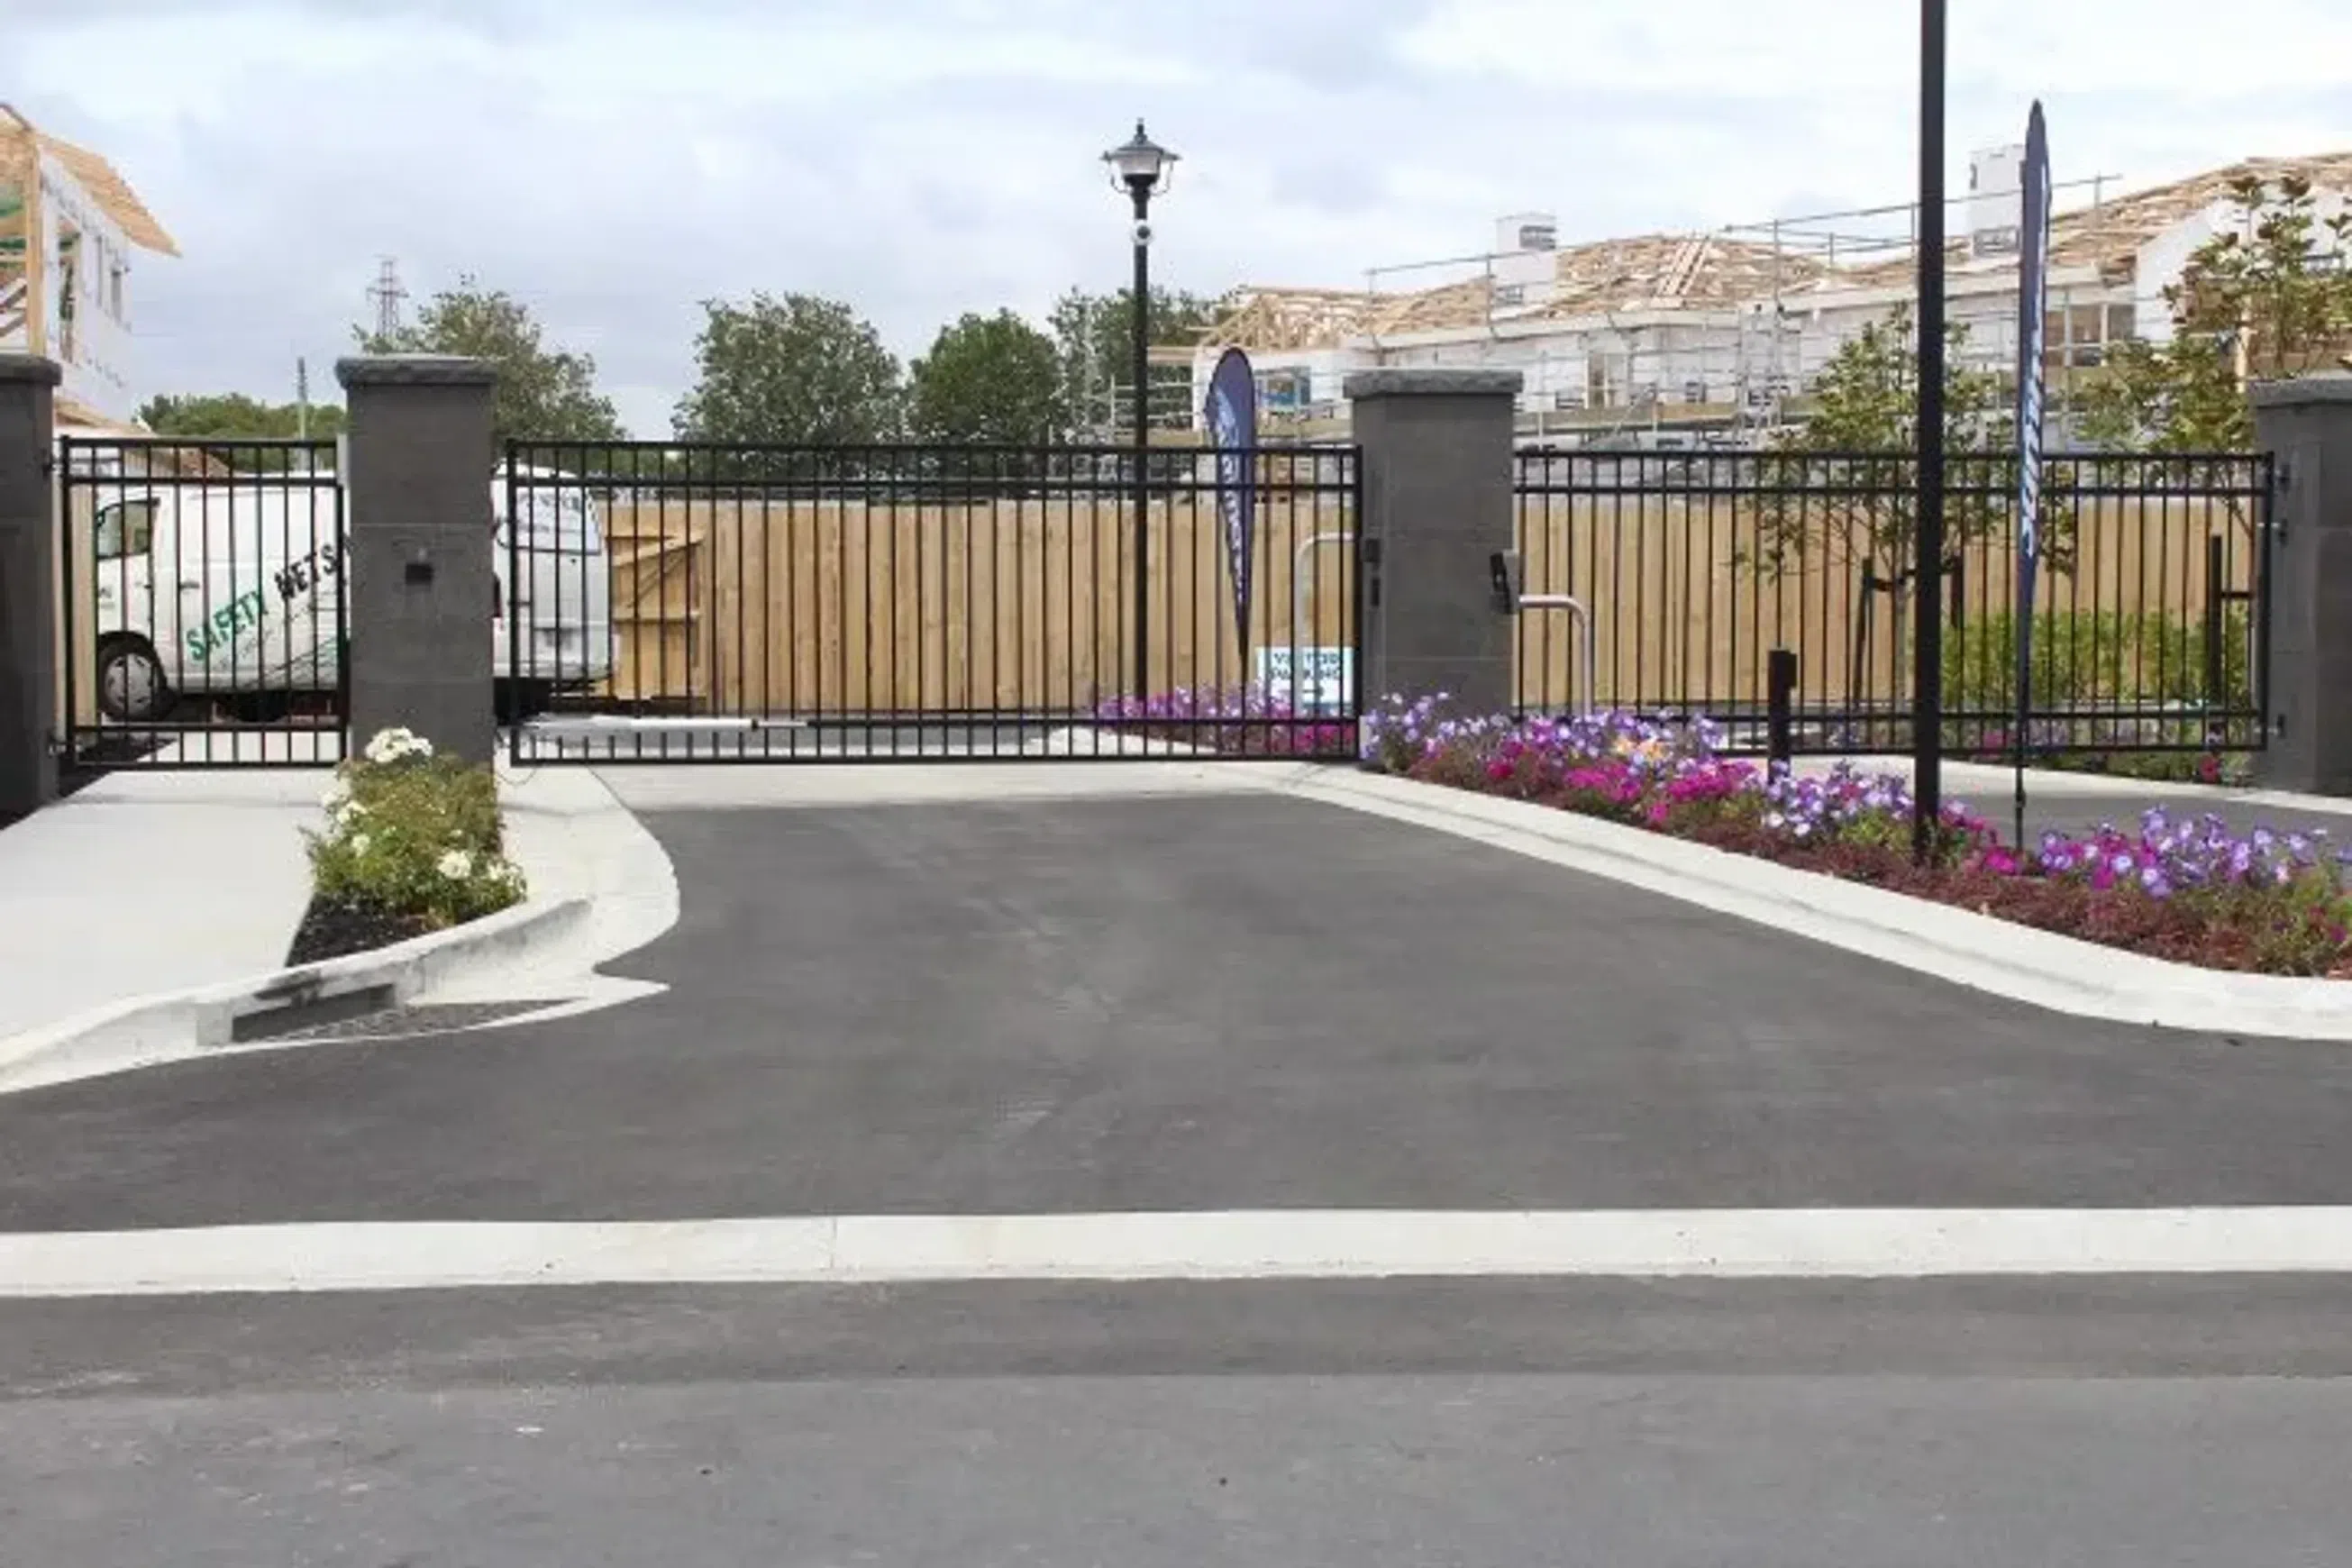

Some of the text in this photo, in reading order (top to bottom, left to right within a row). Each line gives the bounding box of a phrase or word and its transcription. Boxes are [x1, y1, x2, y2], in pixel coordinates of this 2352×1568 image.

[187, 591, 269, 661] SAFETY
[274, 543, 341, 601] NETS
[1273, 652, 1339, 664] VITOR
[1268, 667, 1342, 680] PAKNG
